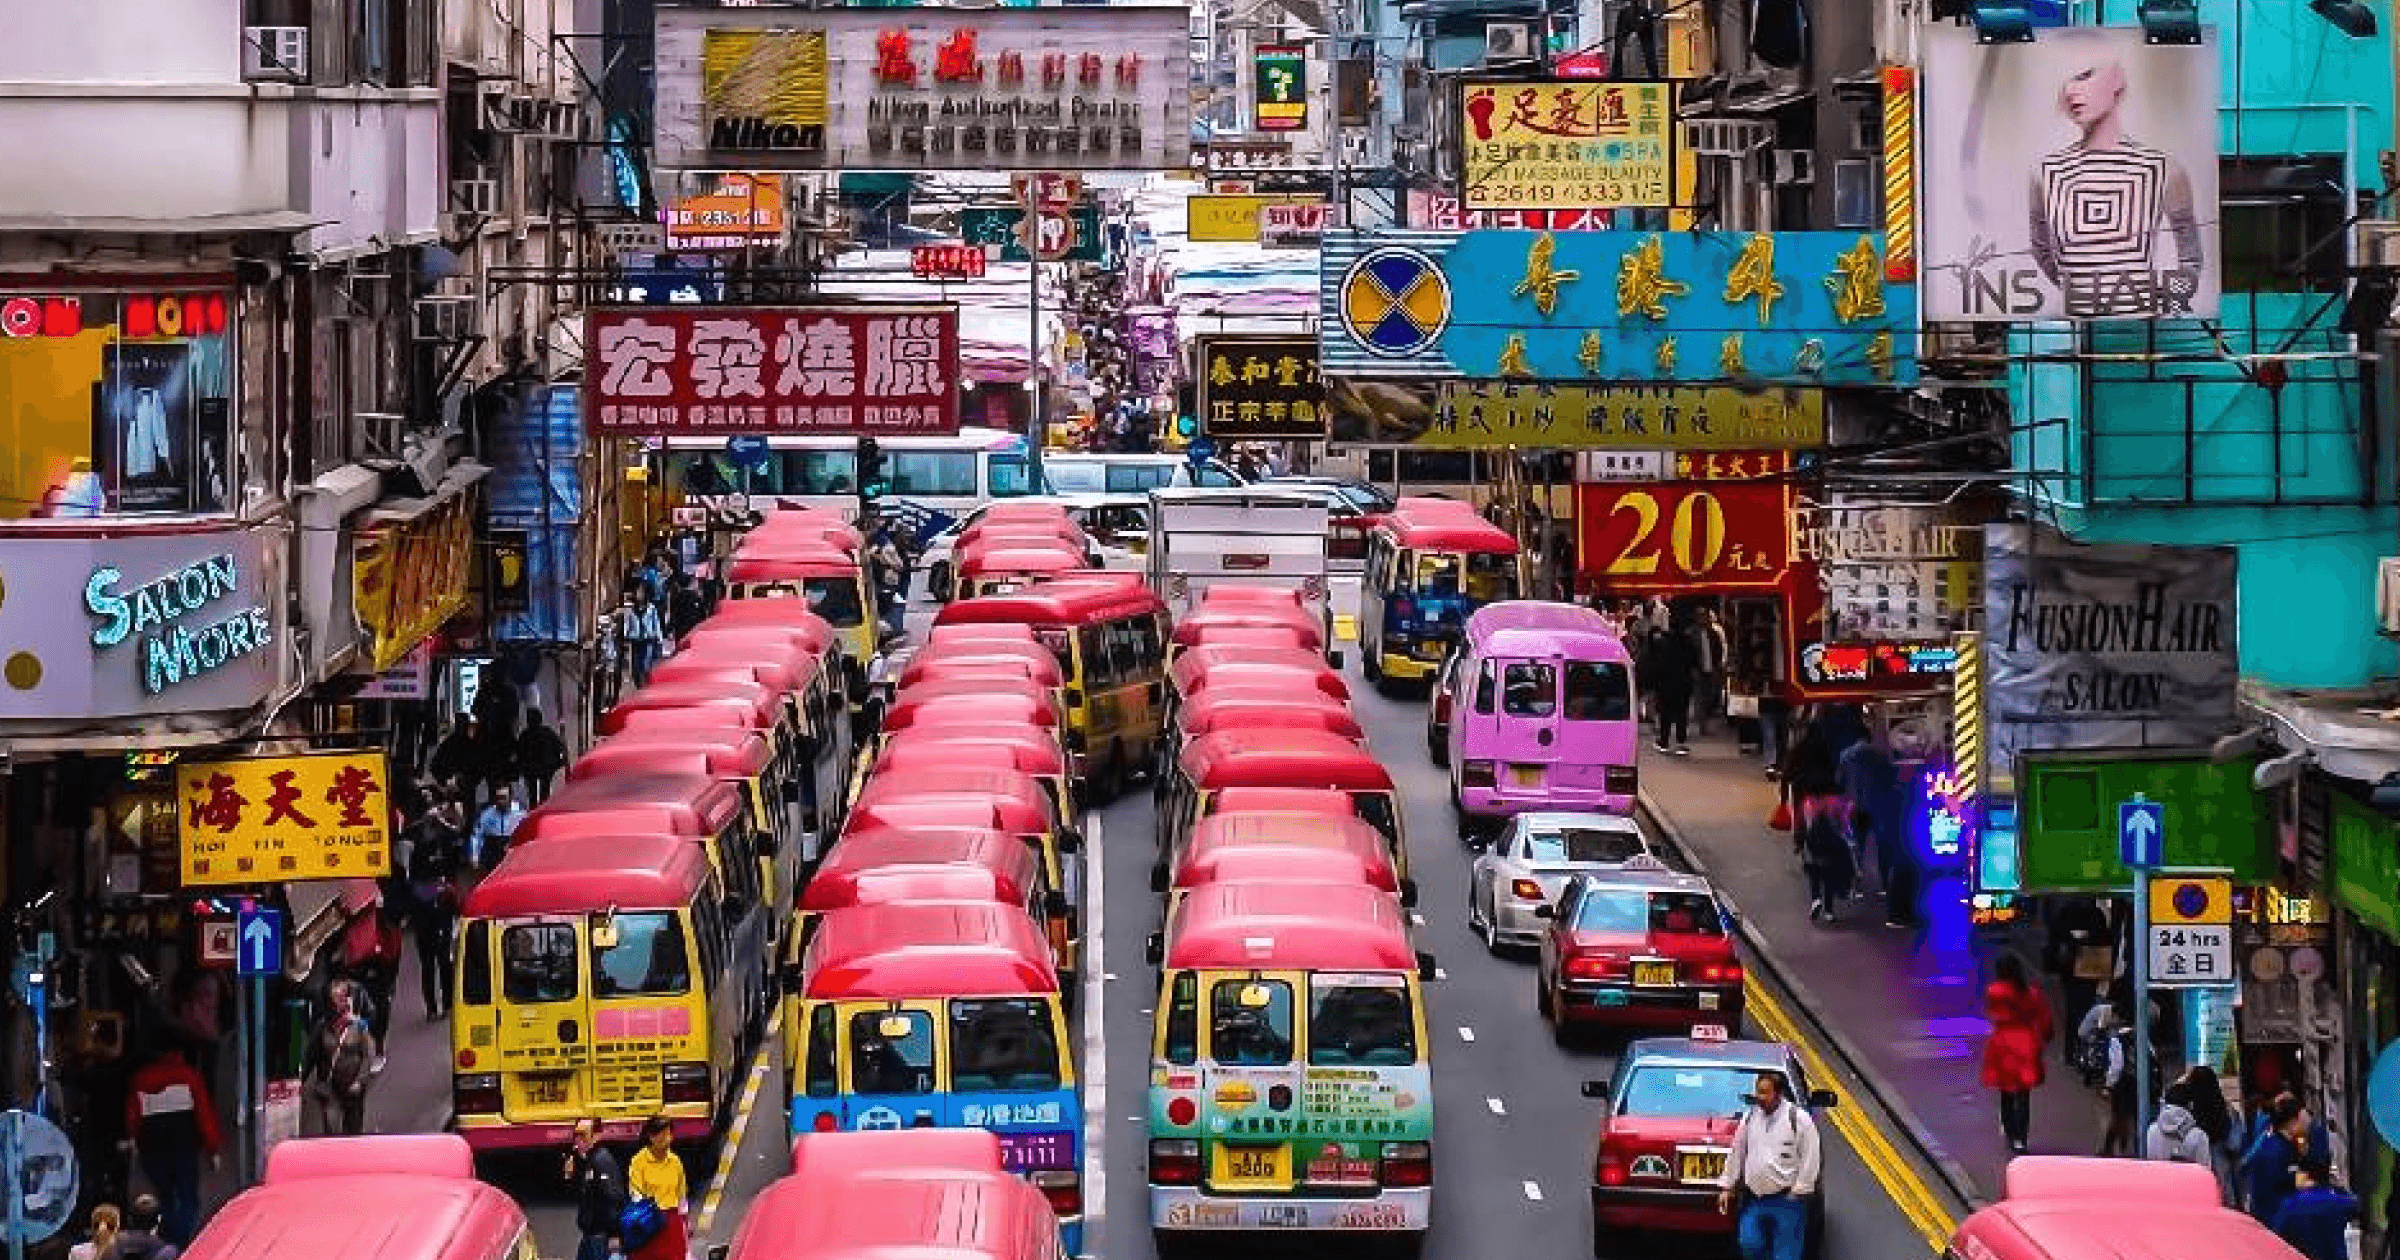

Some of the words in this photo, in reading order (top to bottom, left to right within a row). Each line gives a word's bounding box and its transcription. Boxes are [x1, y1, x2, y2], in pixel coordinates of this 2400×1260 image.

[710, 117, 823, 148] Nikon
[1514, 166, 1593, 182] MASSAGE
[1957, 269, 2046, 315] INS
[2064, 269, 2199, 315] HAIR
[599, 318, 945, 398] 宏發燒臘
[1606, 491, 1726, 575] 20
[86, 553, 237, 646] SALON
[149, 608, 272, 693] MORE
[2063, 672, 2165, 711] SALON
[189, 765, 381, 834] 海天堂
[2159, 930, 2186, 946] 24
[2191, 930, 2221, 946] hrs
[2166, 953, 2214, 975] 全日
